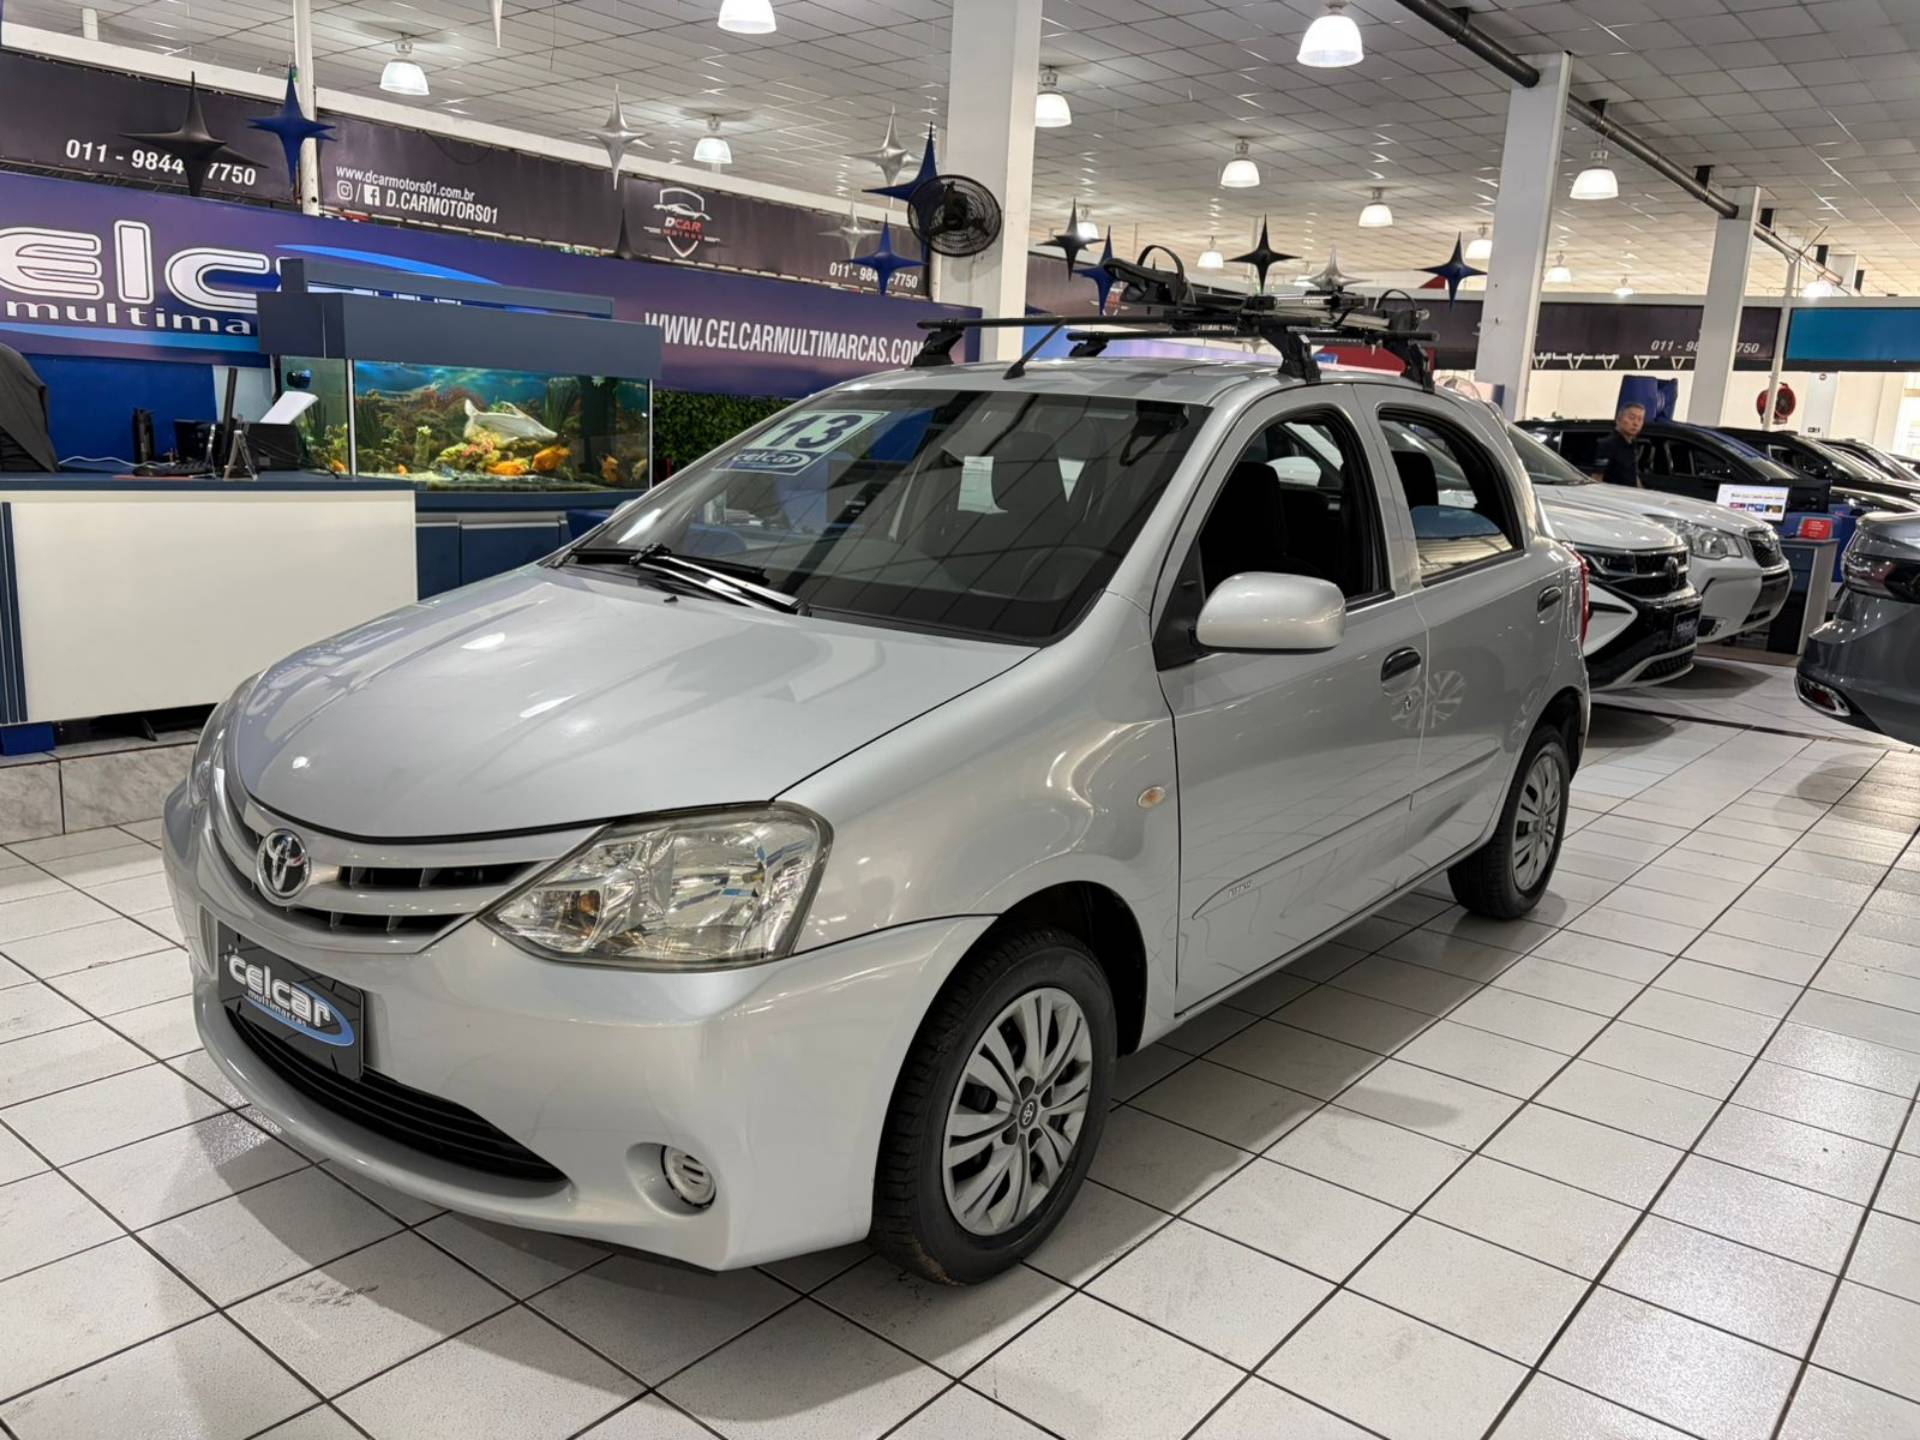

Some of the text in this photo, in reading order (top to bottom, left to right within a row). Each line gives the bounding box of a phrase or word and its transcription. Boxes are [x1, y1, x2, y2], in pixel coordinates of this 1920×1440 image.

[66, 139, 107, 162] 011
[336, 166, 475, 201] www.dcarmotors01.com.br
[386, 190, 498, 224] D.CARMOTORS01
[829, 262, 849, 278] 011
[6, 301, 251, 335] multima
[1651, 340, 1675, 351] 011
[766, 414, 863, 448] 13
[229, 954, 331, 1027] celcar
